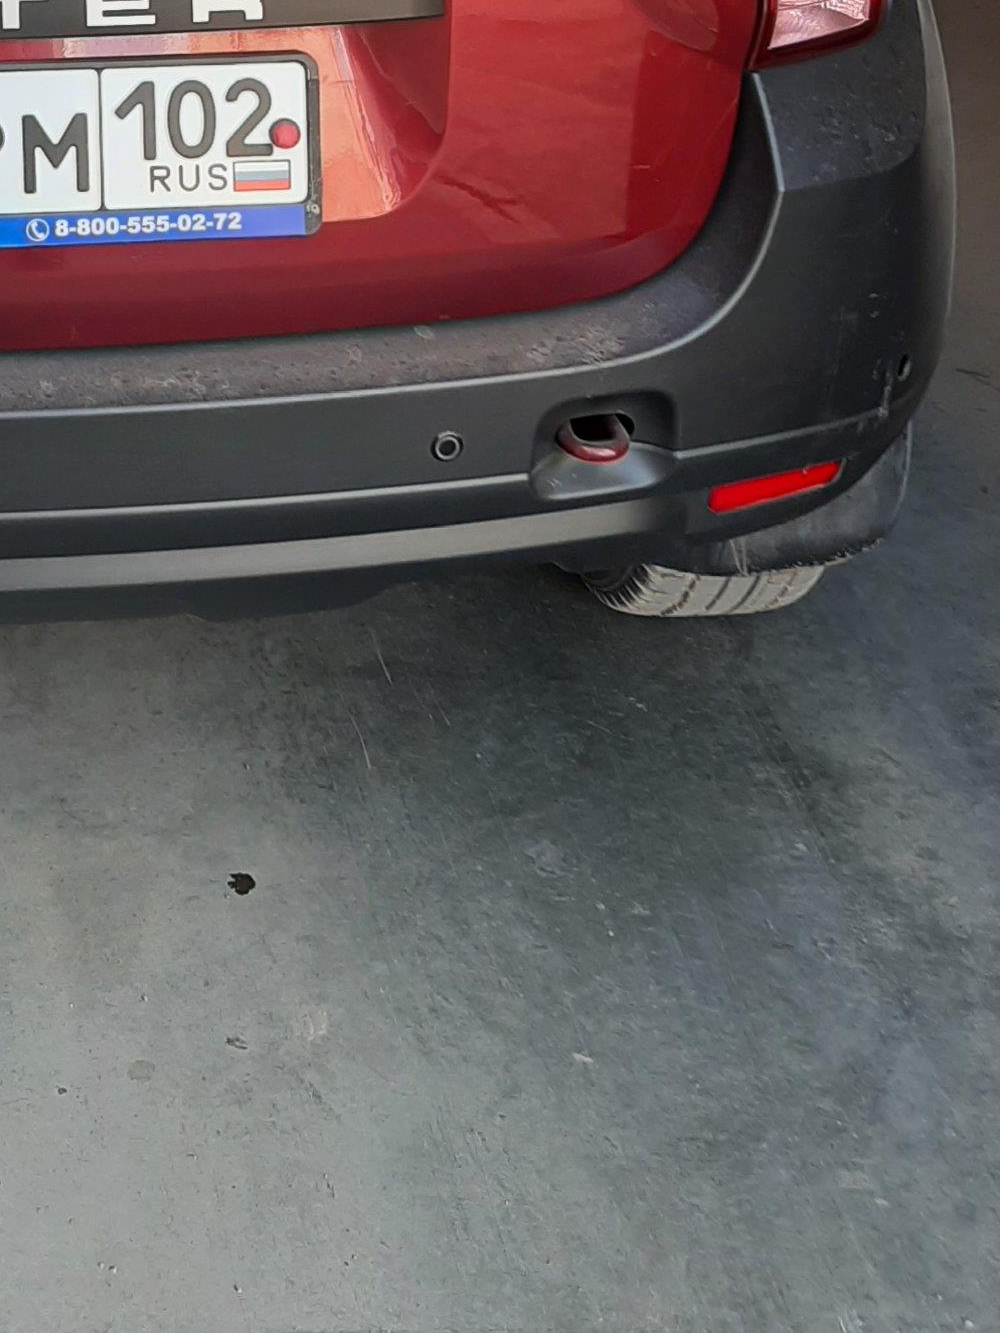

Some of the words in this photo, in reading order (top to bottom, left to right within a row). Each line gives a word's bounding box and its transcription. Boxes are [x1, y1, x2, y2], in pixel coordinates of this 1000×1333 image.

[115, 78, 273, 159] 102
[149, 160, 228, 193] RUS
[54, 212, 243, 238] 8-800-555-02-72
